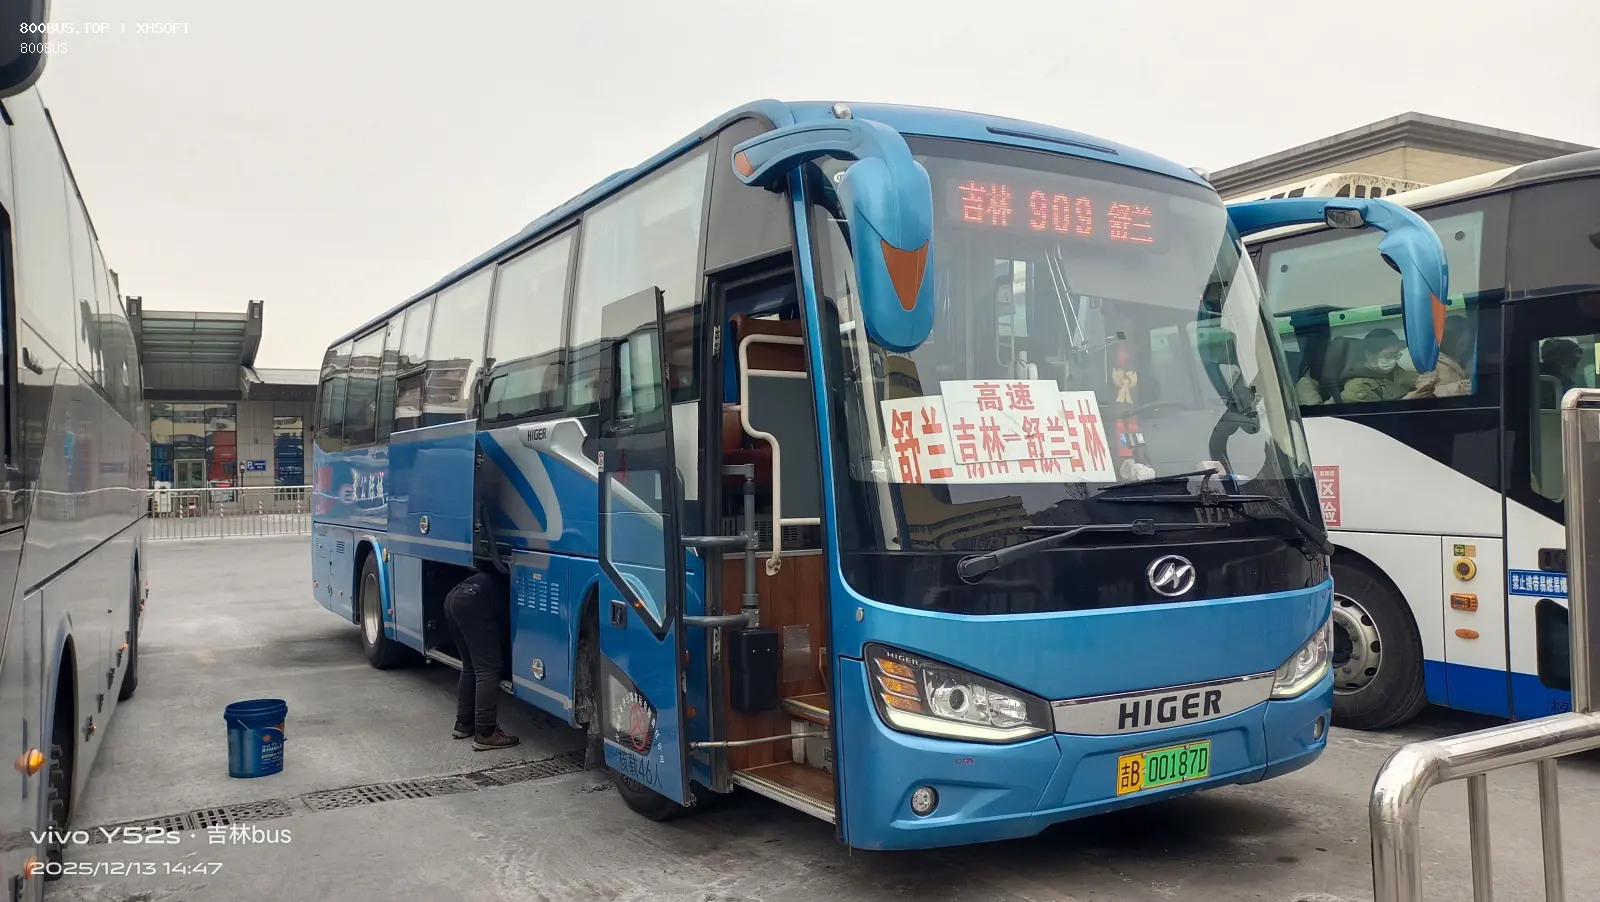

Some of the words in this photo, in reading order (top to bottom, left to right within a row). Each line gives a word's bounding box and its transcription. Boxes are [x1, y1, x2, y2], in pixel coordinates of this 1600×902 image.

[958, 179, 1013, 227] 吉林
[1029, 189, 1094, 237] 909
[1107, 200, 1154, 243] 舒兰
[973, 382, 1035, 412] 高速
[527, 427, 548, 442] HIGER
[891, 405, 955, 484] 舒兰
[952, 416, 1006, 463] 吉林
[1021, 415, 1071, 459] 舒兰
[886, 650, 920, 667] HIGER
[1117, 688, 1222, 730] HIGER
[1148, 746, 1208, 783] 00187D
